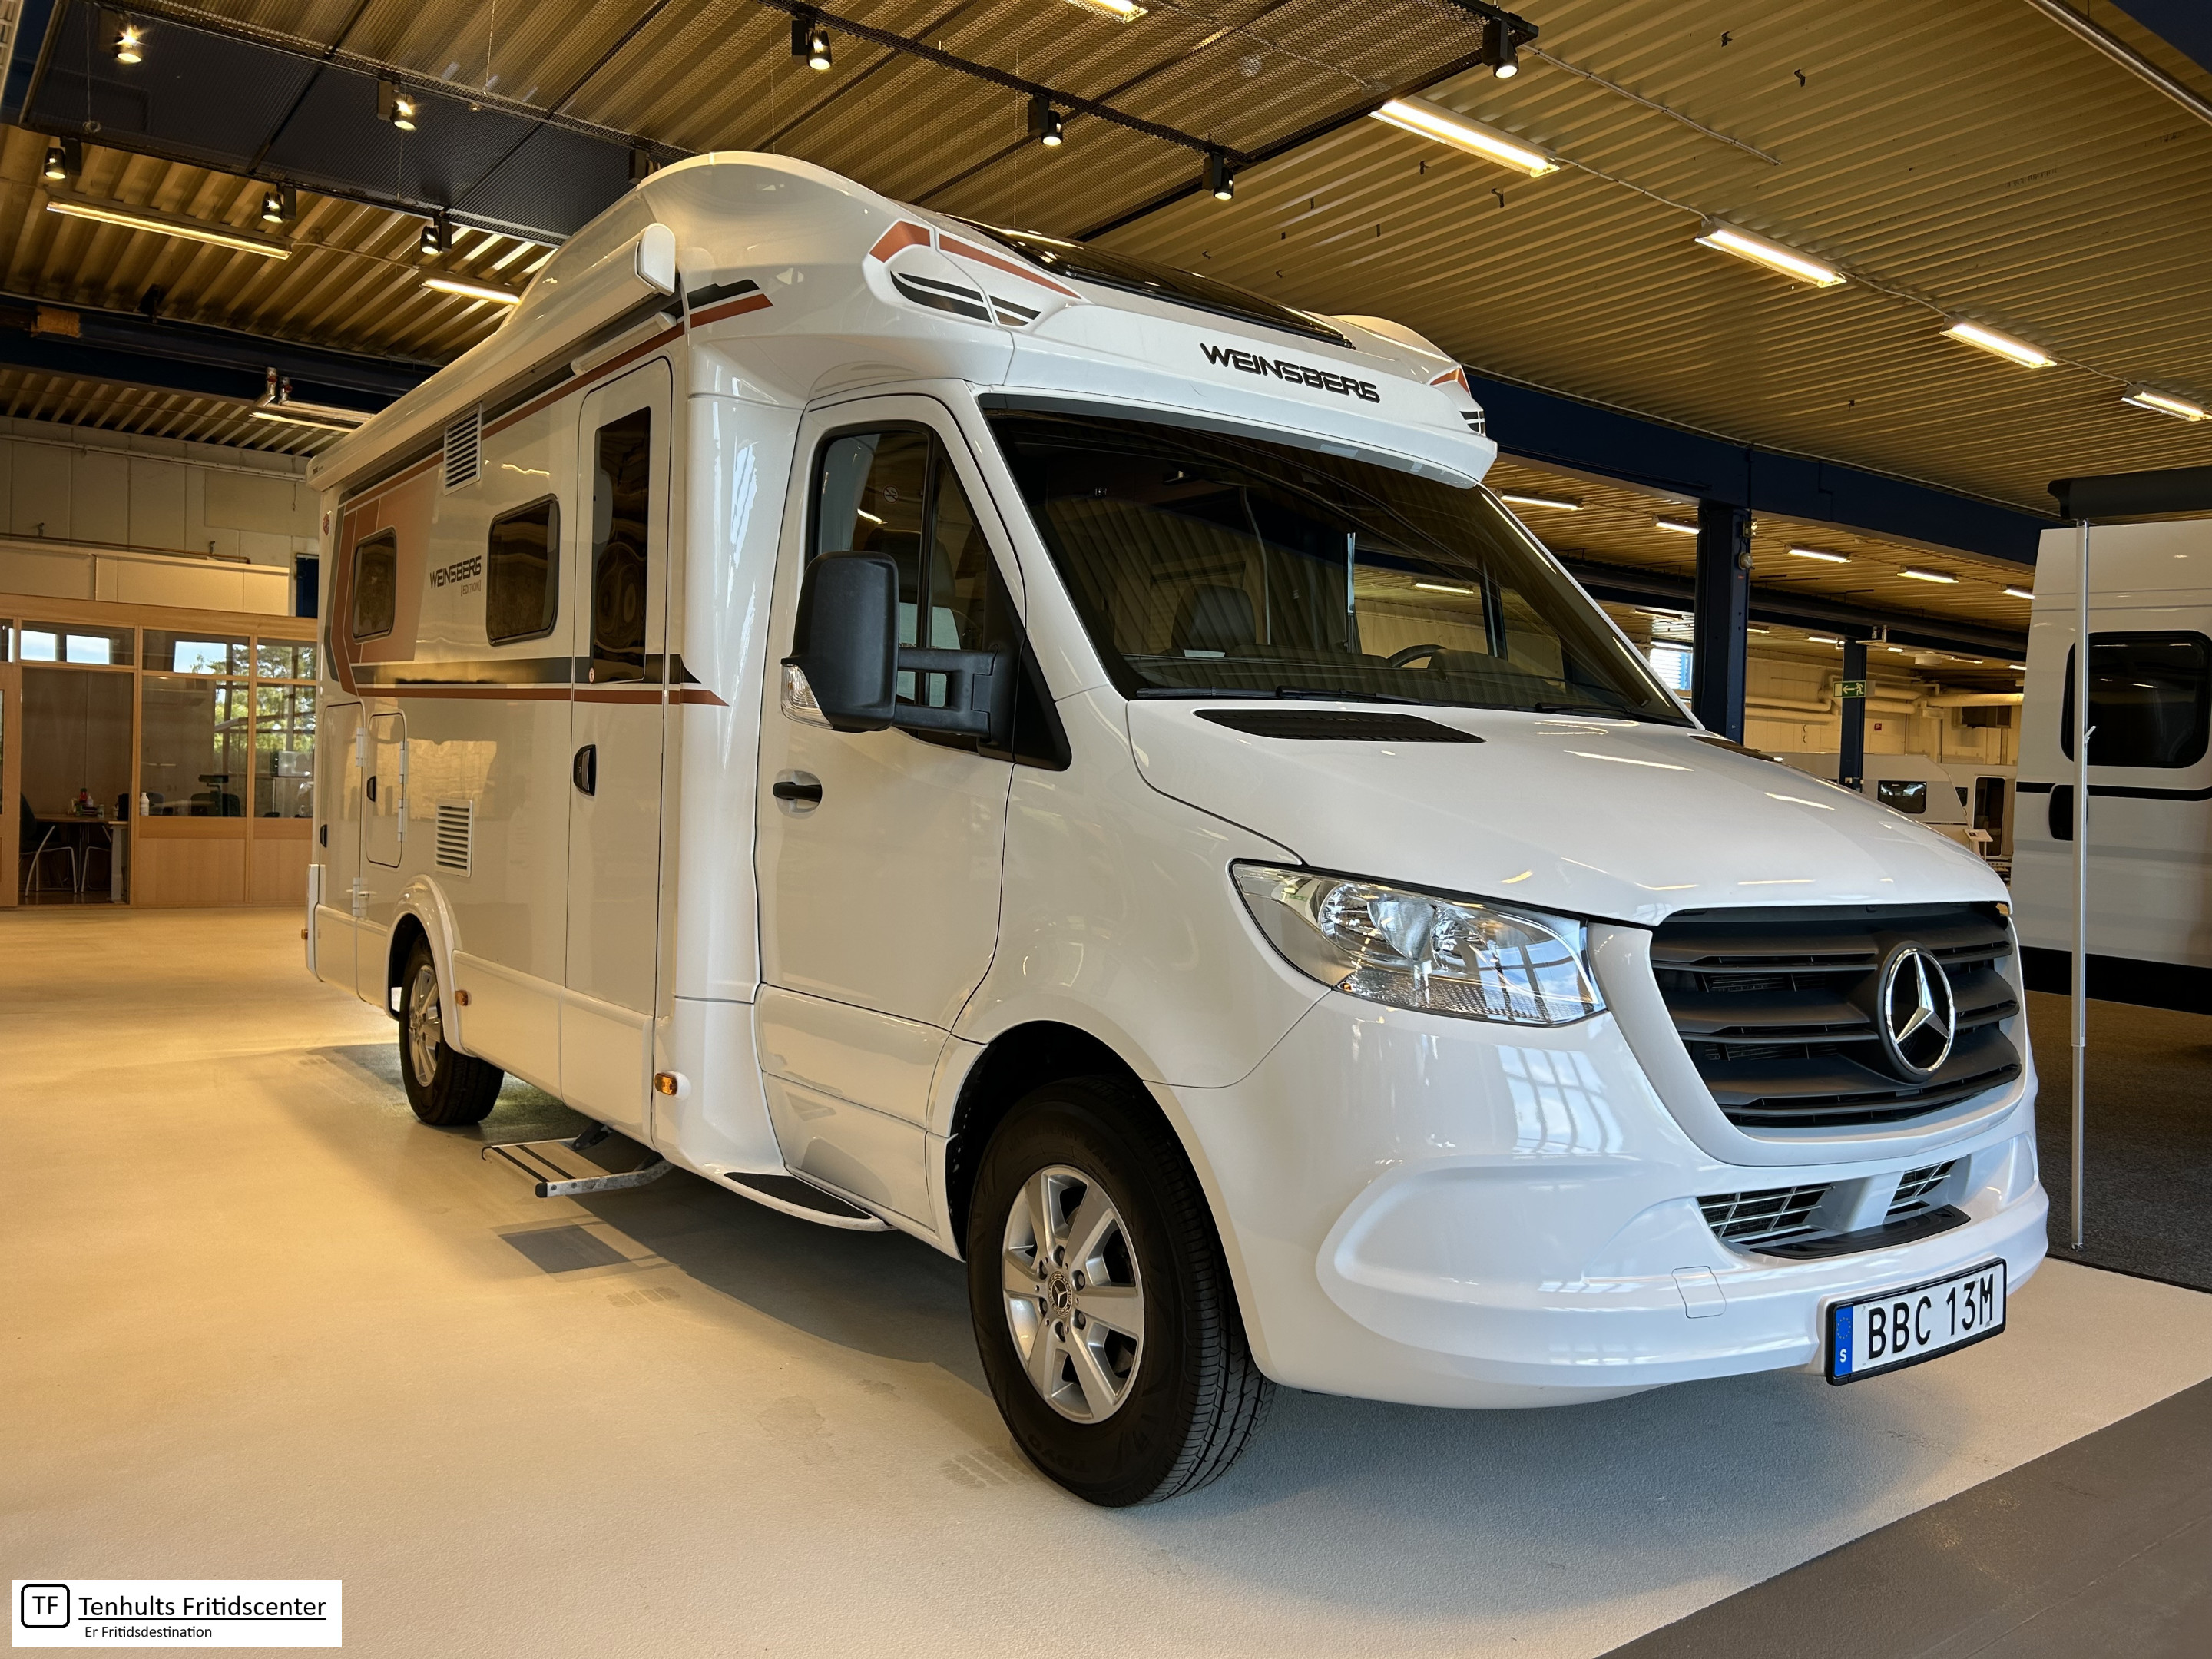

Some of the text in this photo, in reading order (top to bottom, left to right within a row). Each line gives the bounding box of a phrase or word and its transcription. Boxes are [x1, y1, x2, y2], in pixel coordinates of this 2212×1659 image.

[1199, 343, 1380, 404] WEINSBERG
[429, 555, 482, 589] WEINSBERG
[1868, 1273, 1994, 1360] BBC 13M
[1839, 1348, 1847, 1363] S
